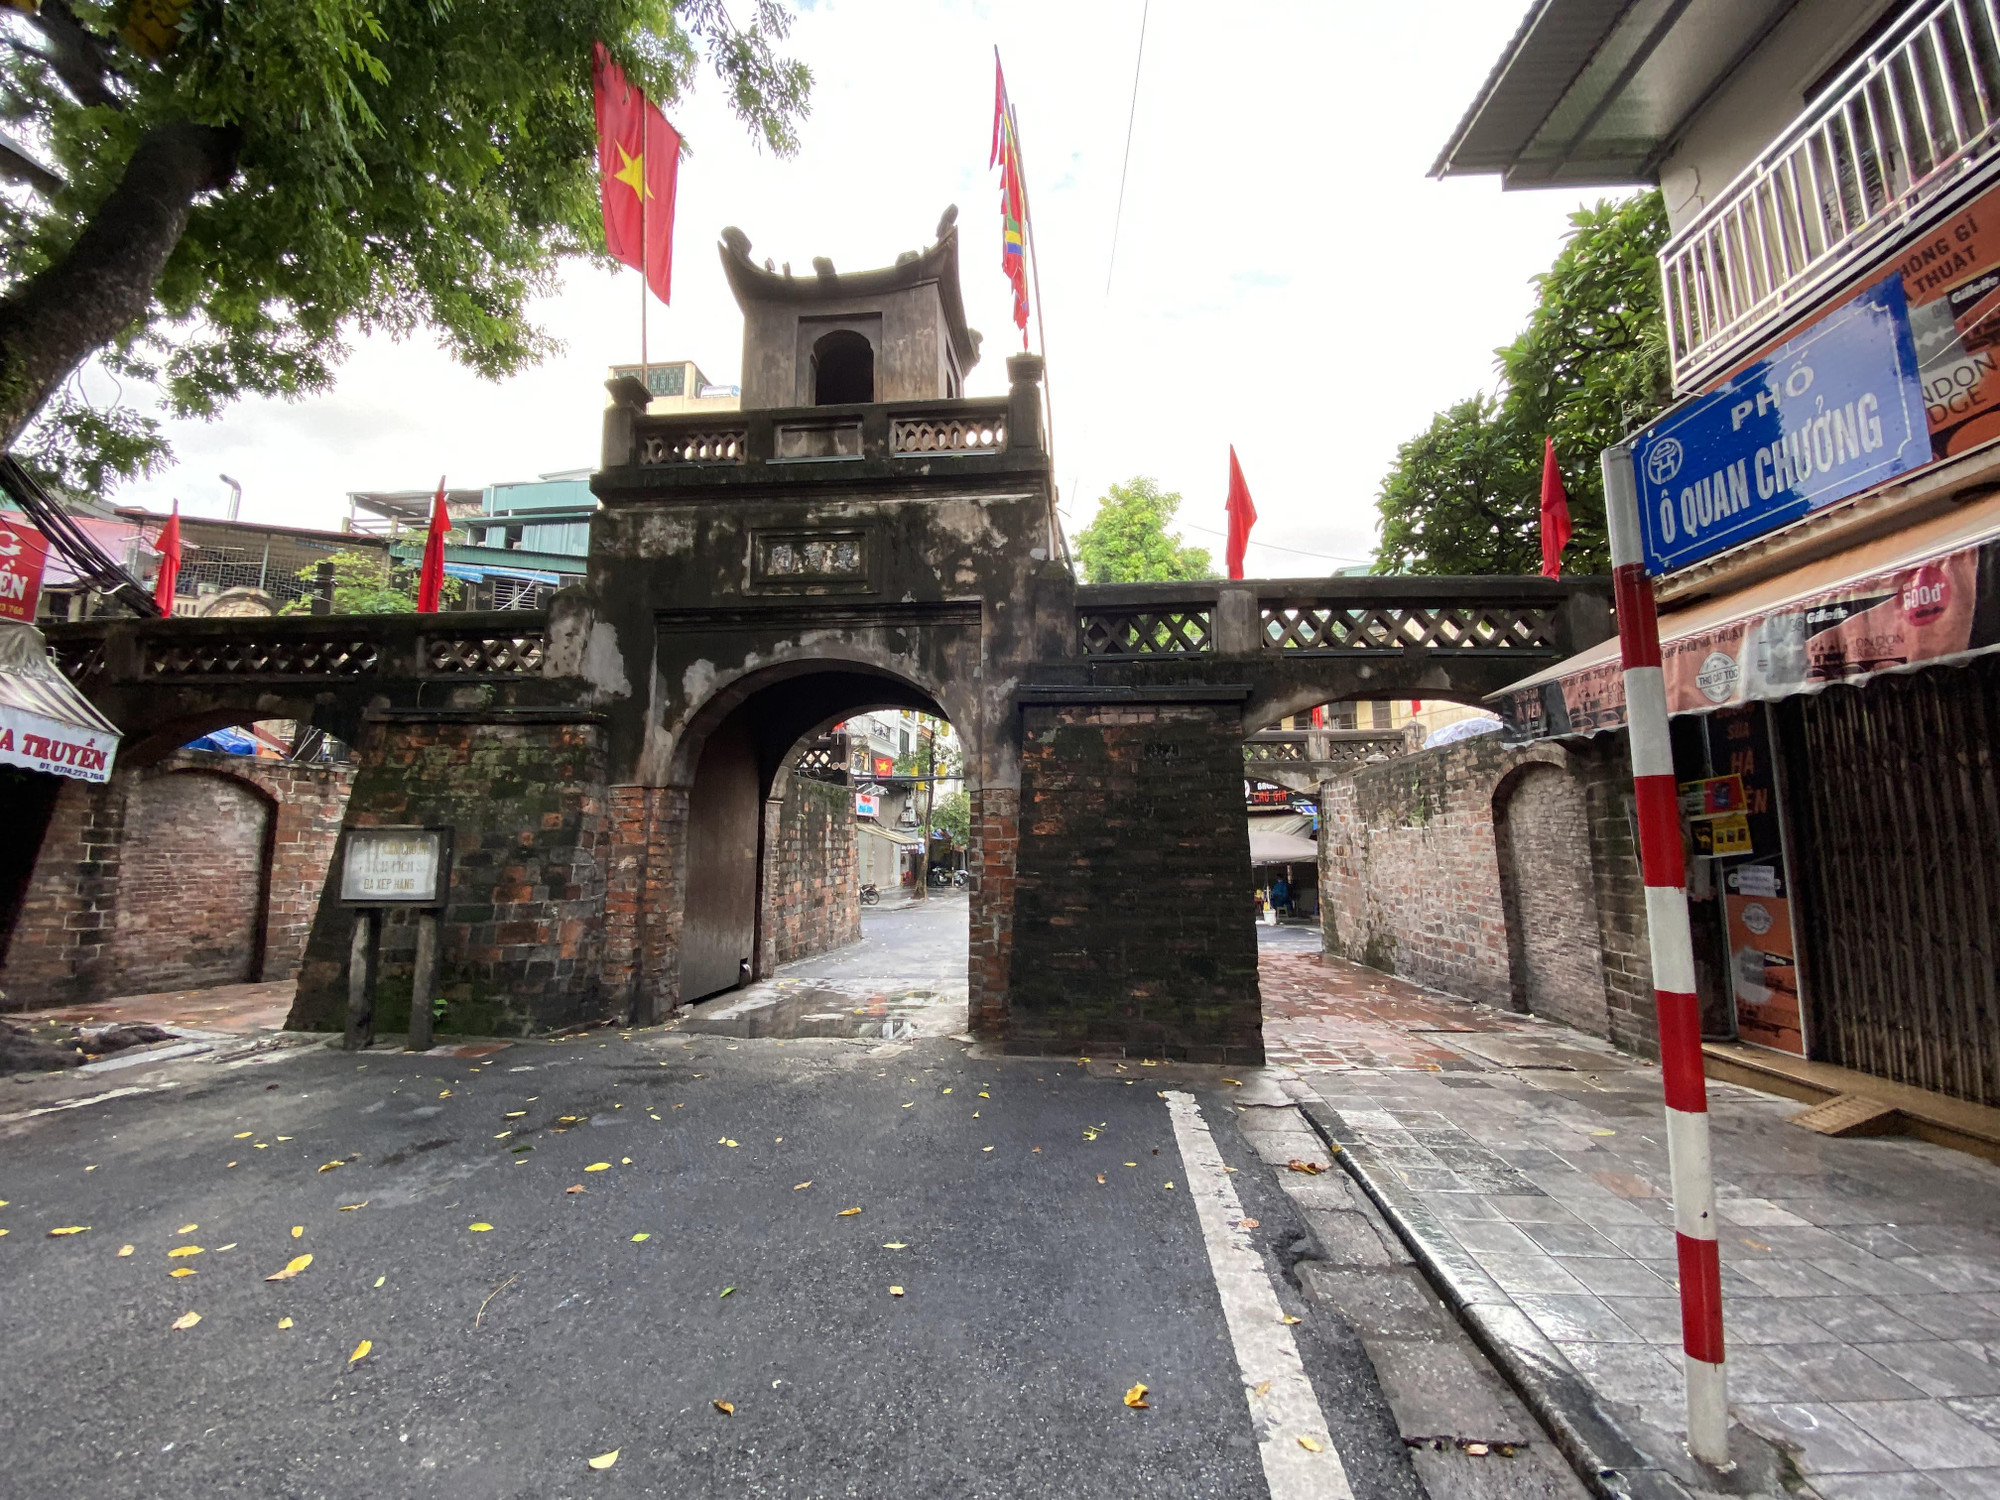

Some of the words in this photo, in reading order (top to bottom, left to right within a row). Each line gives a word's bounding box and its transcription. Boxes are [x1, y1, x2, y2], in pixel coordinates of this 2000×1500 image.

[1731, 351, 1815, 432] PHỐ
[1659, 489, 1676, 544] Ô
[1680, 457, 1751, 538] QUAN
[1754, 392, 1884, 500] CHƯỞNG
